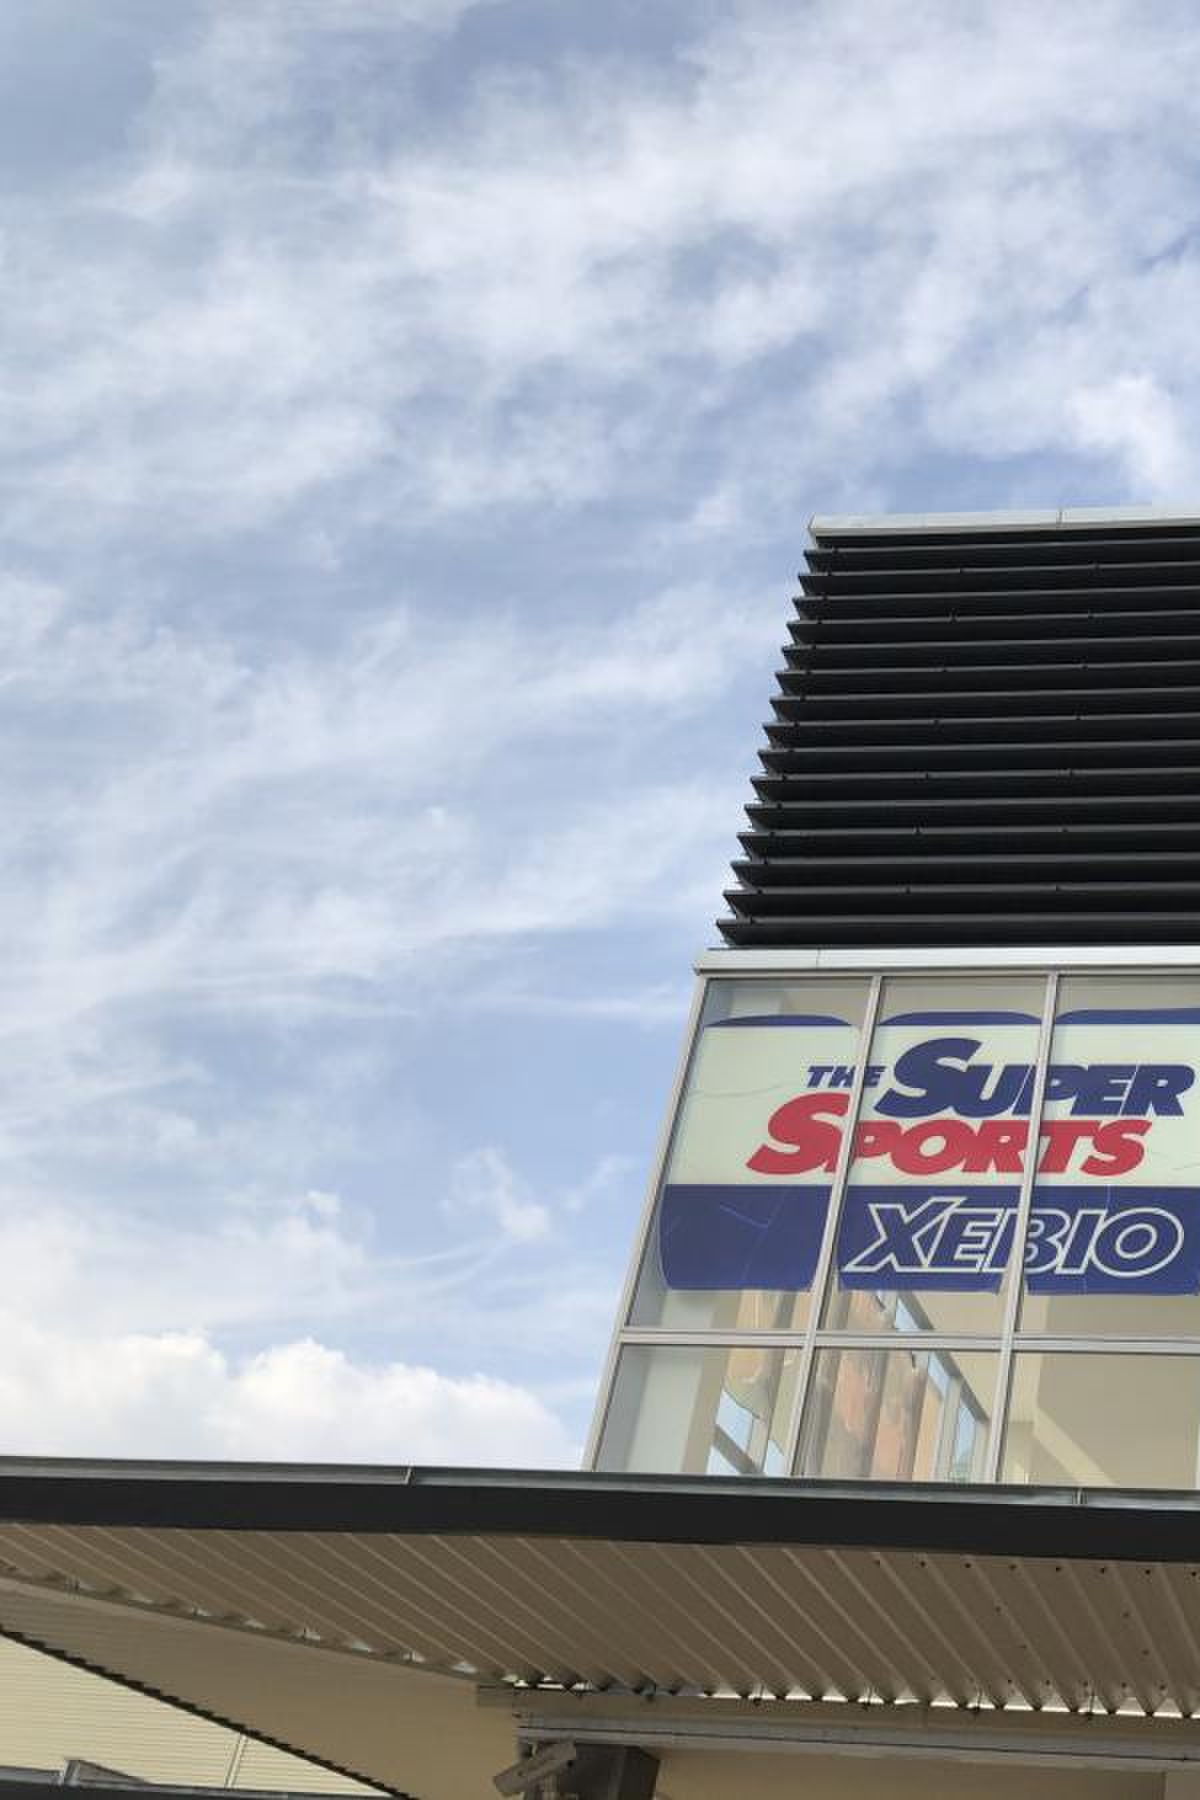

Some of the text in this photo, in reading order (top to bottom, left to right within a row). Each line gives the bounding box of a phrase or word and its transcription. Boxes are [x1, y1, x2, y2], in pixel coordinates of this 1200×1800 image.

[806, 1037, 1196, 1118] THE SUPER
[745, 1091, 1152, 1177] SPORTS
[841, 1195, 1186, 1278] XEBIO
